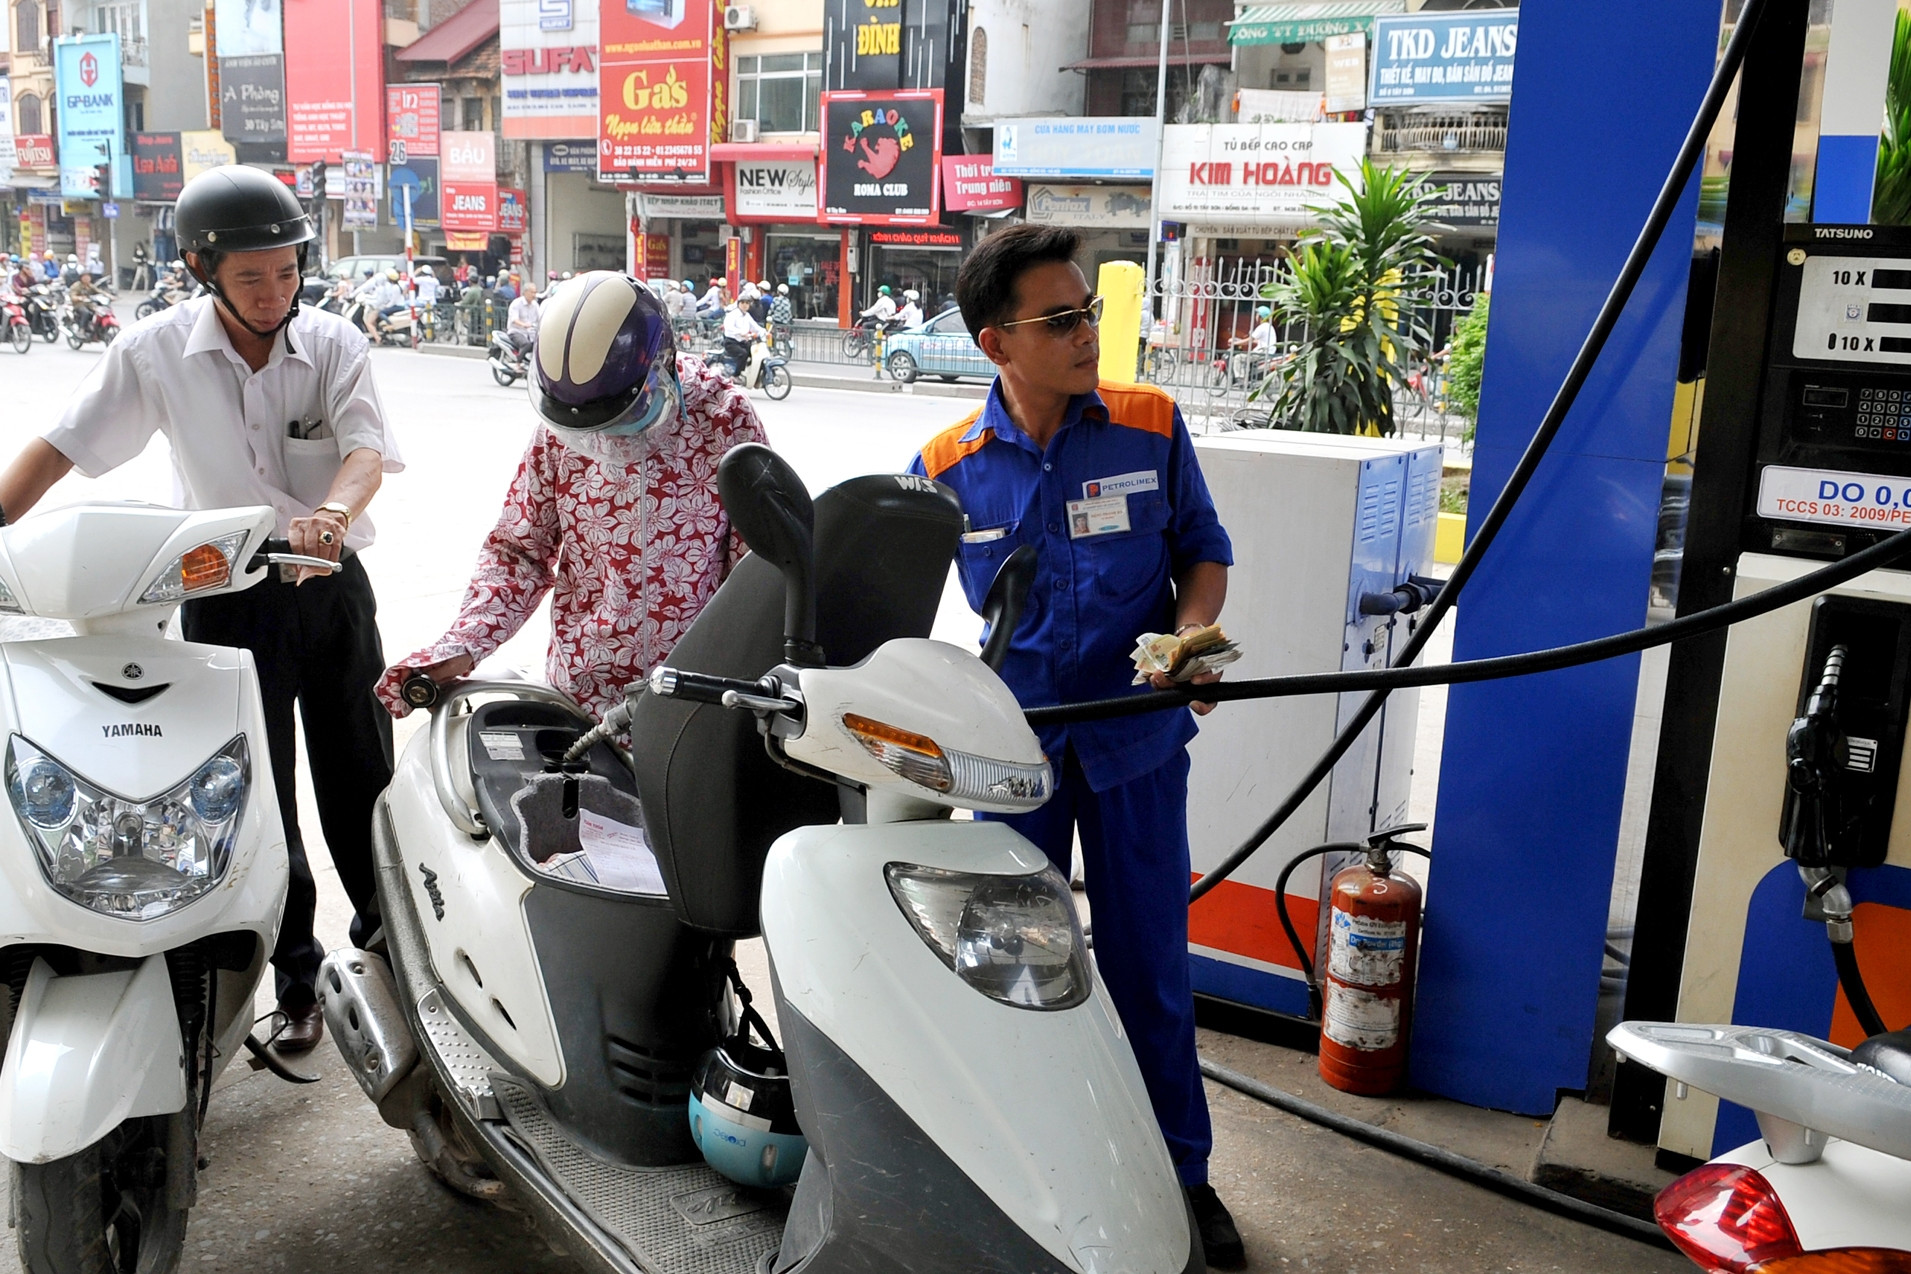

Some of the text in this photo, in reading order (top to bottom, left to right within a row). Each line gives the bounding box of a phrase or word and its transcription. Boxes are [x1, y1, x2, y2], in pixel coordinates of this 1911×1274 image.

[857, 16, 901, 56] ĐÌNH
[1387, 24, 1518, 60] TKD JEANS
[1414, 66, 1432, 83] MAY
[241, 84, 279, 104] Phòng
[622, 68, 688, 111] Gas
[402, 90, 418, 109] in
[606, 113, 640, 141] Ngọn
[843, 108, 914, 153] KARAOKE
[390, 140, 407, 164] 26
[1240, 137, 1260, 151] BẾP
[1264, 141, 1287, 151] CAO
[18, 144, 51, 164] FUJITSU
[1189, 156, 1333, 186] KIM HOÀNG
[739, 169, 816, 195] NEW Style
[762, 187, 782, 195] Office
[854, 184, 909, 197] ROMA CLUB
[955, 179, 1012, 195] Trung niên
[1442, 182, 1500, 201] JEANS
[452, 195, 486, 211] JEANS
[499, 203, 523, 218] JEANS
[1815, 228, 1873, 239] TATSUNO
[1833, 270, 1866, 286] 10 X
[1841, 336, 1874, 351] 10 X
[1102, 477, 1156, 491] PETROLIMEX
[1818, 480, 1865, 503] DO
[1777, 499, 1911, 524] TCCS 03: 2009/PE
[102, 723, 163, 738] YAMAHA
[1373, 877, 1388, 894] 3
